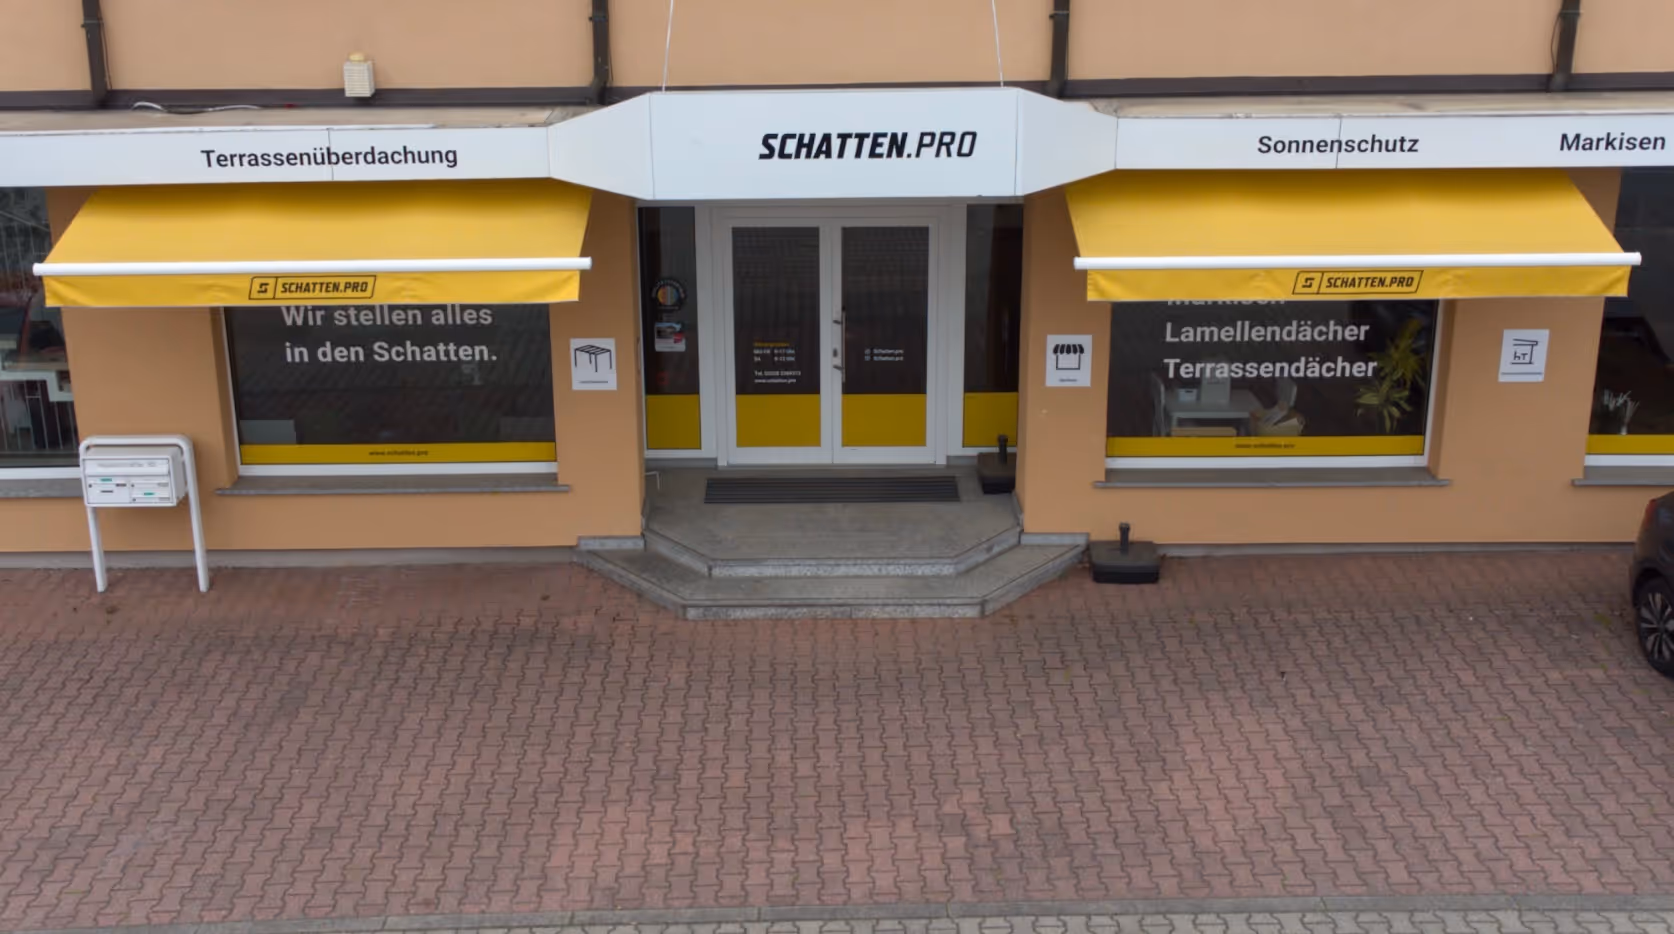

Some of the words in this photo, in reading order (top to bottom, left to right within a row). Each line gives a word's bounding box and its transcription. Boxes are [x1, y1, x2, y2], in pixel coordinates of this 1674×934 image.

[758, 130, 978, 160] SCHATTEN.PRO
[1258, 133, 1420, 155] Sonnenschutz
[1559, 131, 1667, 153] Markisen
[201, 146, 458, 170] Terrassenüberdachung
[281, 281, 369, 294] SCHATTEN.PRO
[1325, 276, 1415, 288] SCHATTEN.PRO
[281, 304, 325, 326] Wir
[333, 303, 422, 326] stellen
[431, 303, 493, 325] alles
[1165, 320, 1370, 342] Lamellendächer
[285, 342, 309, 363] in
[317, 341, 364, 363] den
[373, 341, 498, 362] Schatten.
[1163, 356, 1378, 379] Terrassendächer
